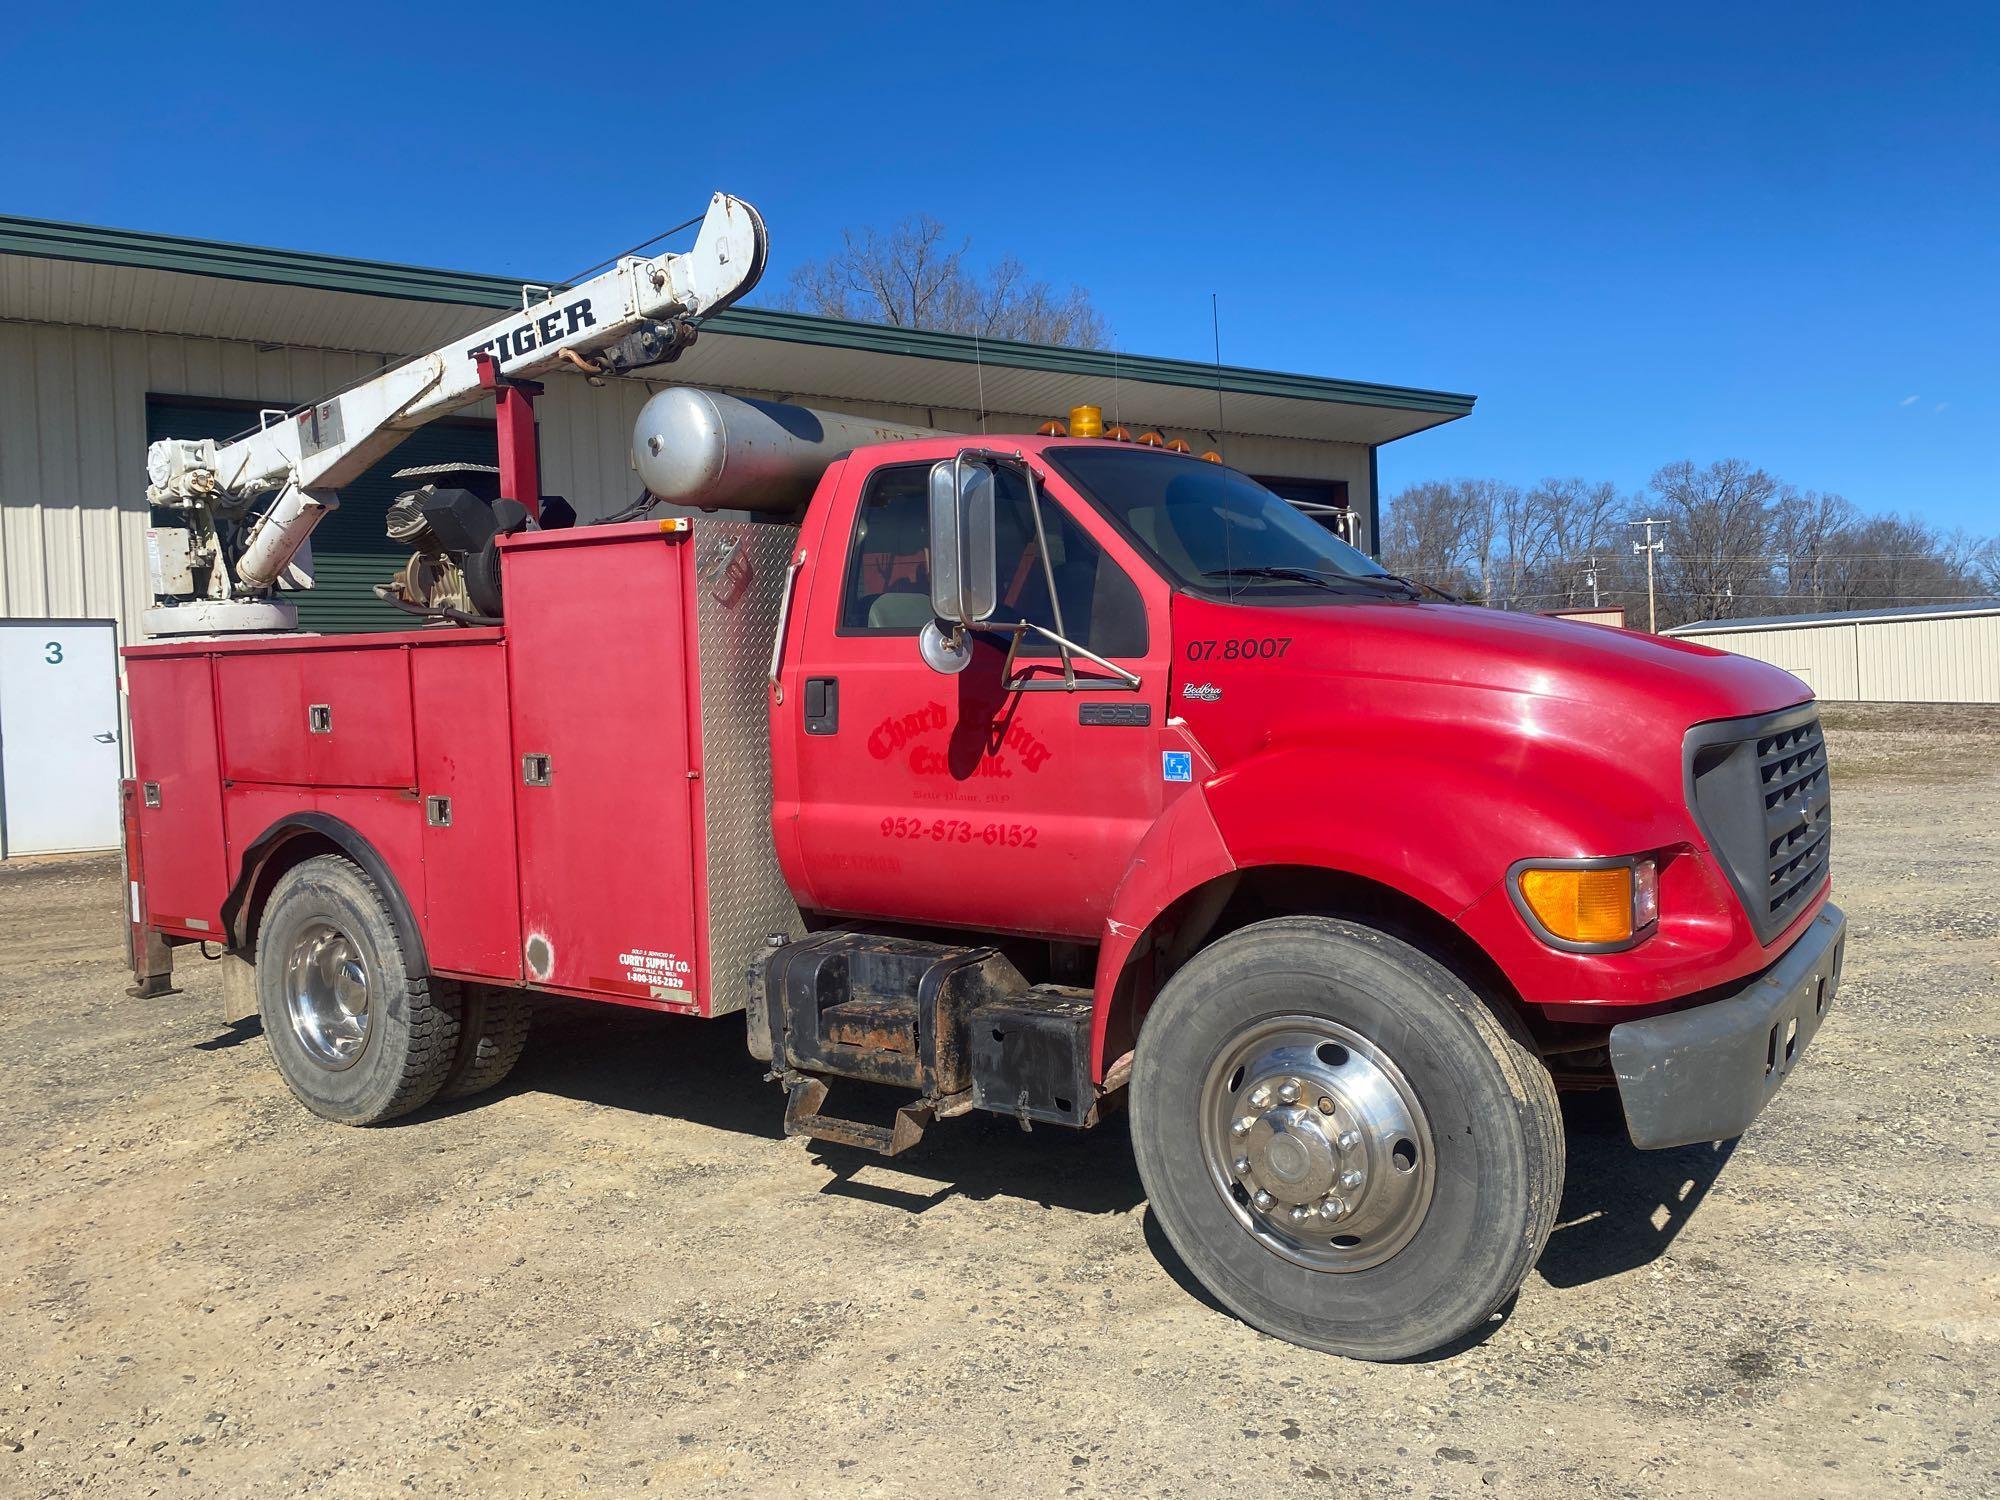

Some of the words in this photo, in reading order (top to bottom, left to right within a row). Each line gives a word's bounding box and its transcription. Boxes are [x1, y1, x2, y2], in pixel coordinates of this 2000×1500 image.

[467, 298, 596, 364] TIGER
[45, 641, 63, 665] 3
[1187, 638, 1292, 662] 07.8007
[881, 816, 1039, 849] 952-873-6152
[619, 953, 645, 967] CURRY
[645, 957, 675, 971] SUPPLY
[675, 961, 691, 973] CO.
